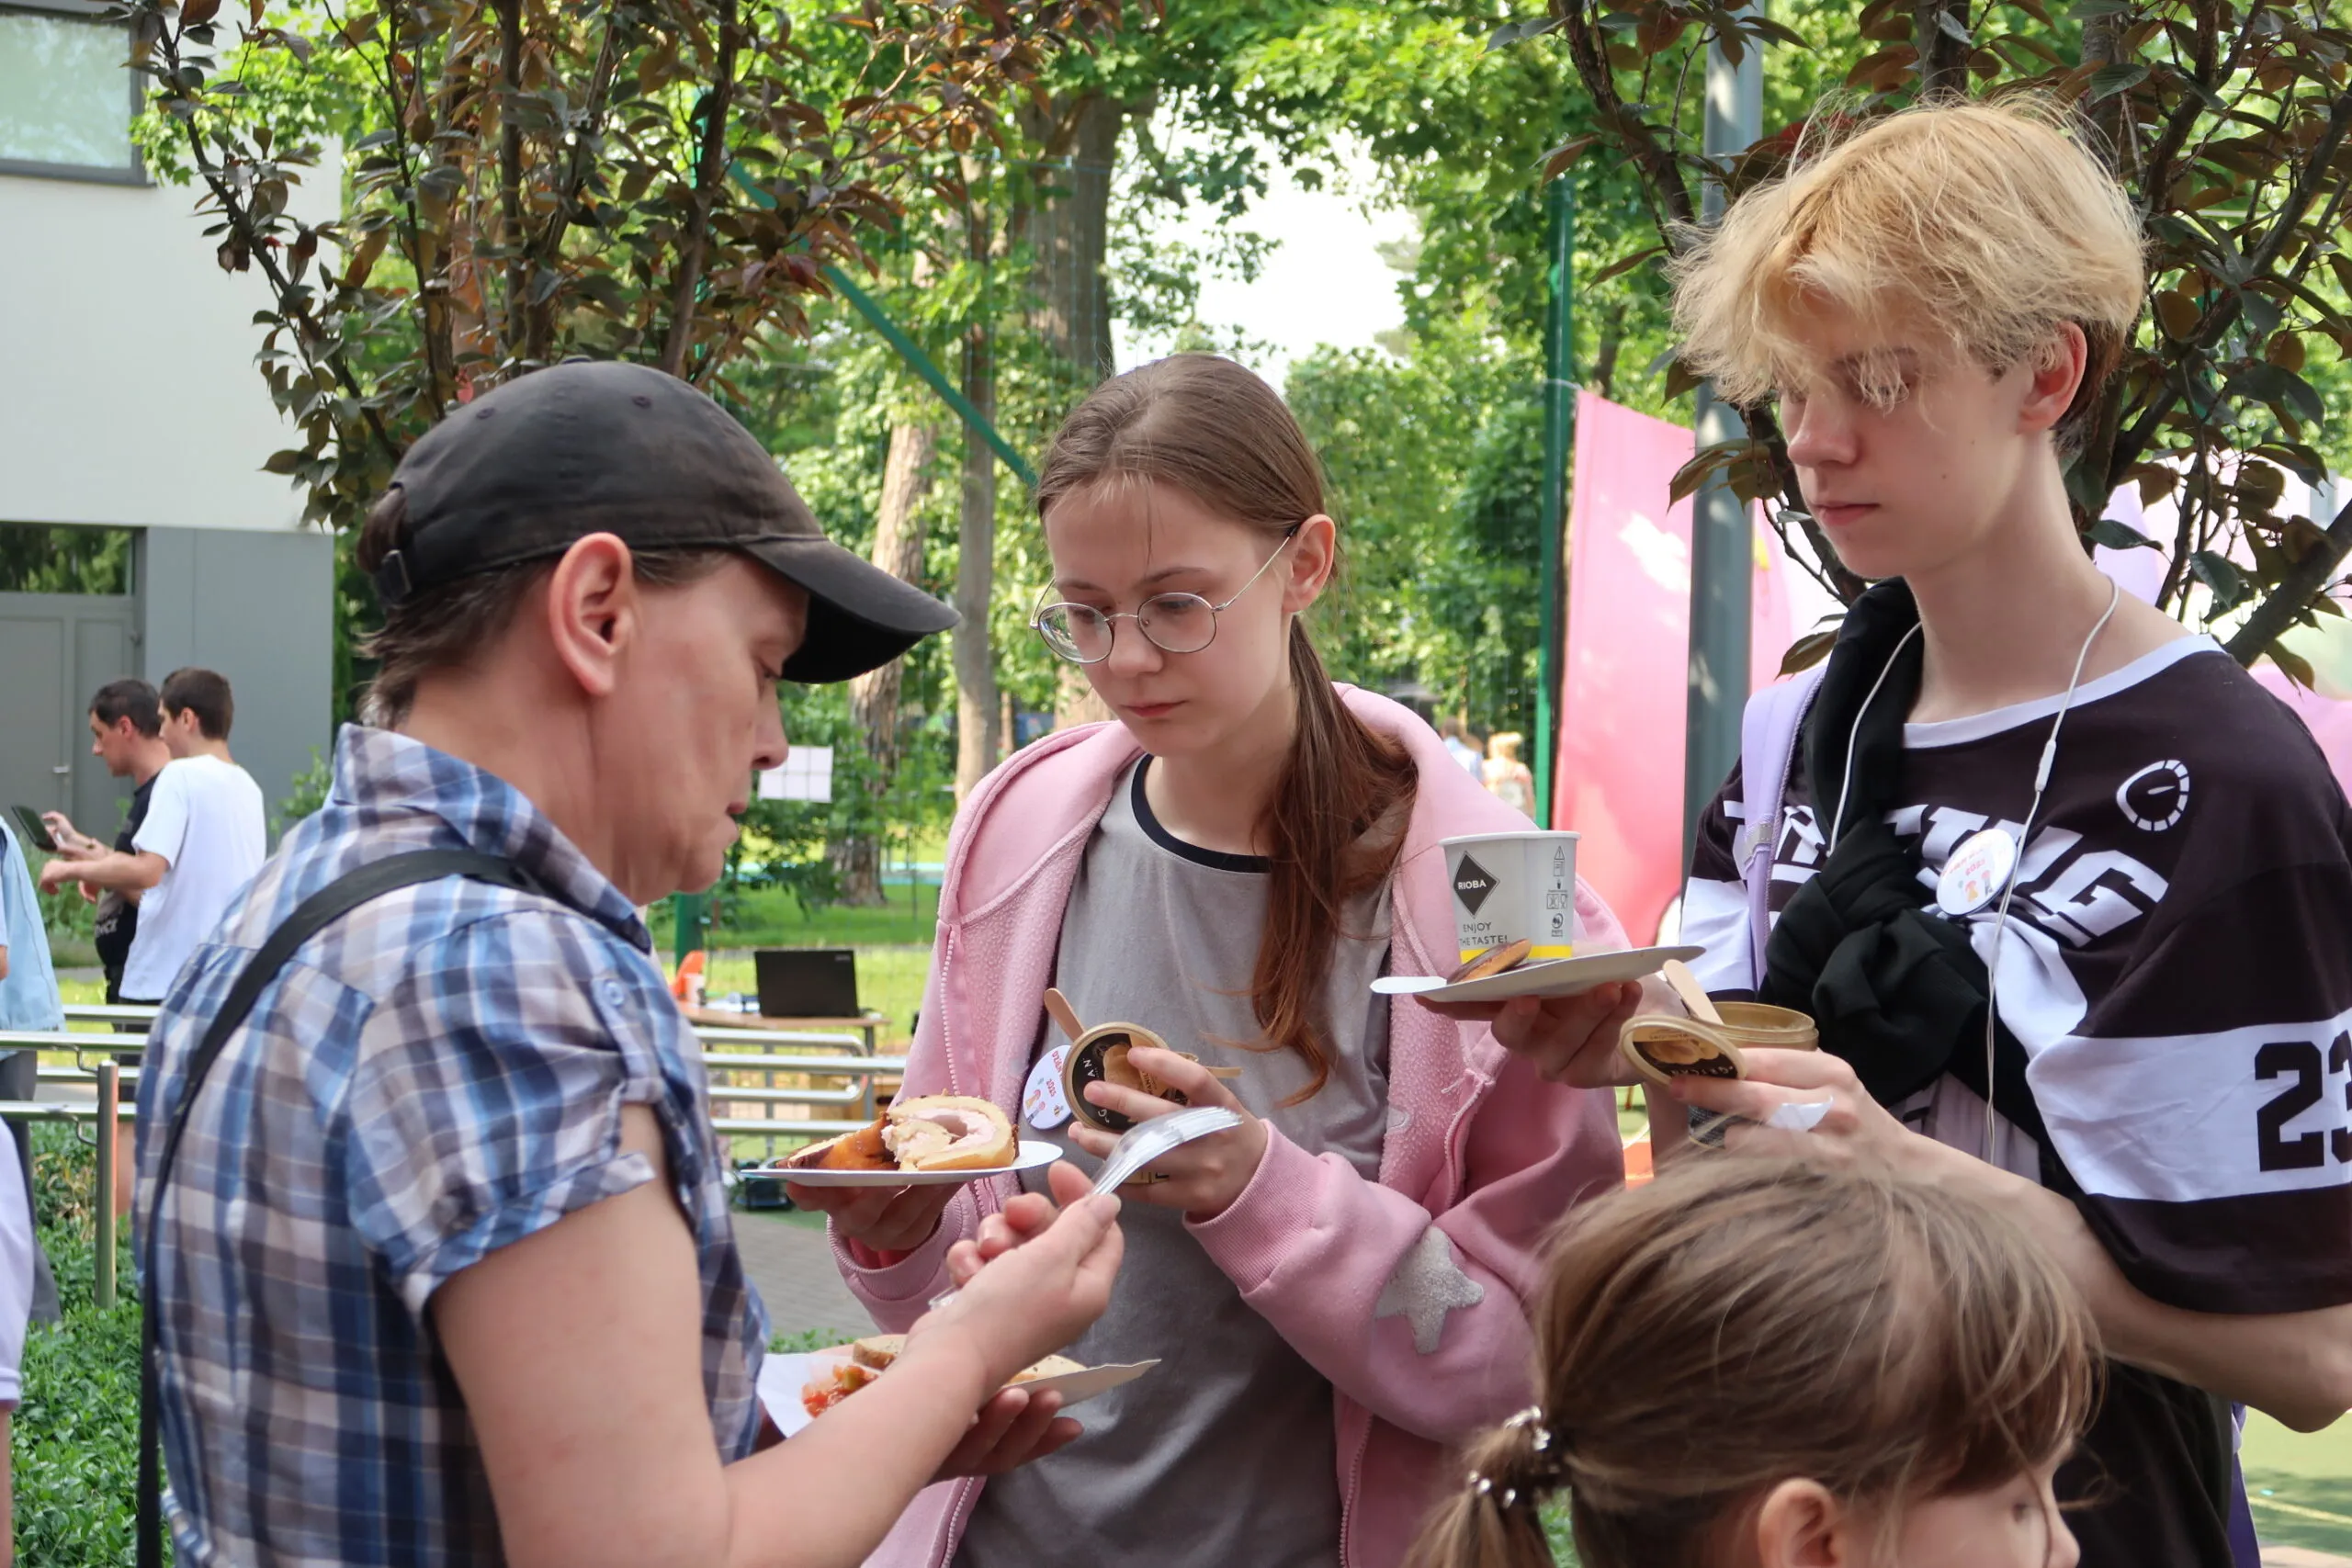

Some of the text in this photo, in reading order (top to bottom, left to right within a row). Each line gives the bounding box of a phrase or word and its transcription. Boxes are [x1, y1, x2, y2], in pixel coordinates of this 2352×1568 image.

[1457, 878, 1487, 890] RIOBA
[1463, 921, 1492, 934] ENJOY
[1472, 934, 1508, 945] TASTE!
